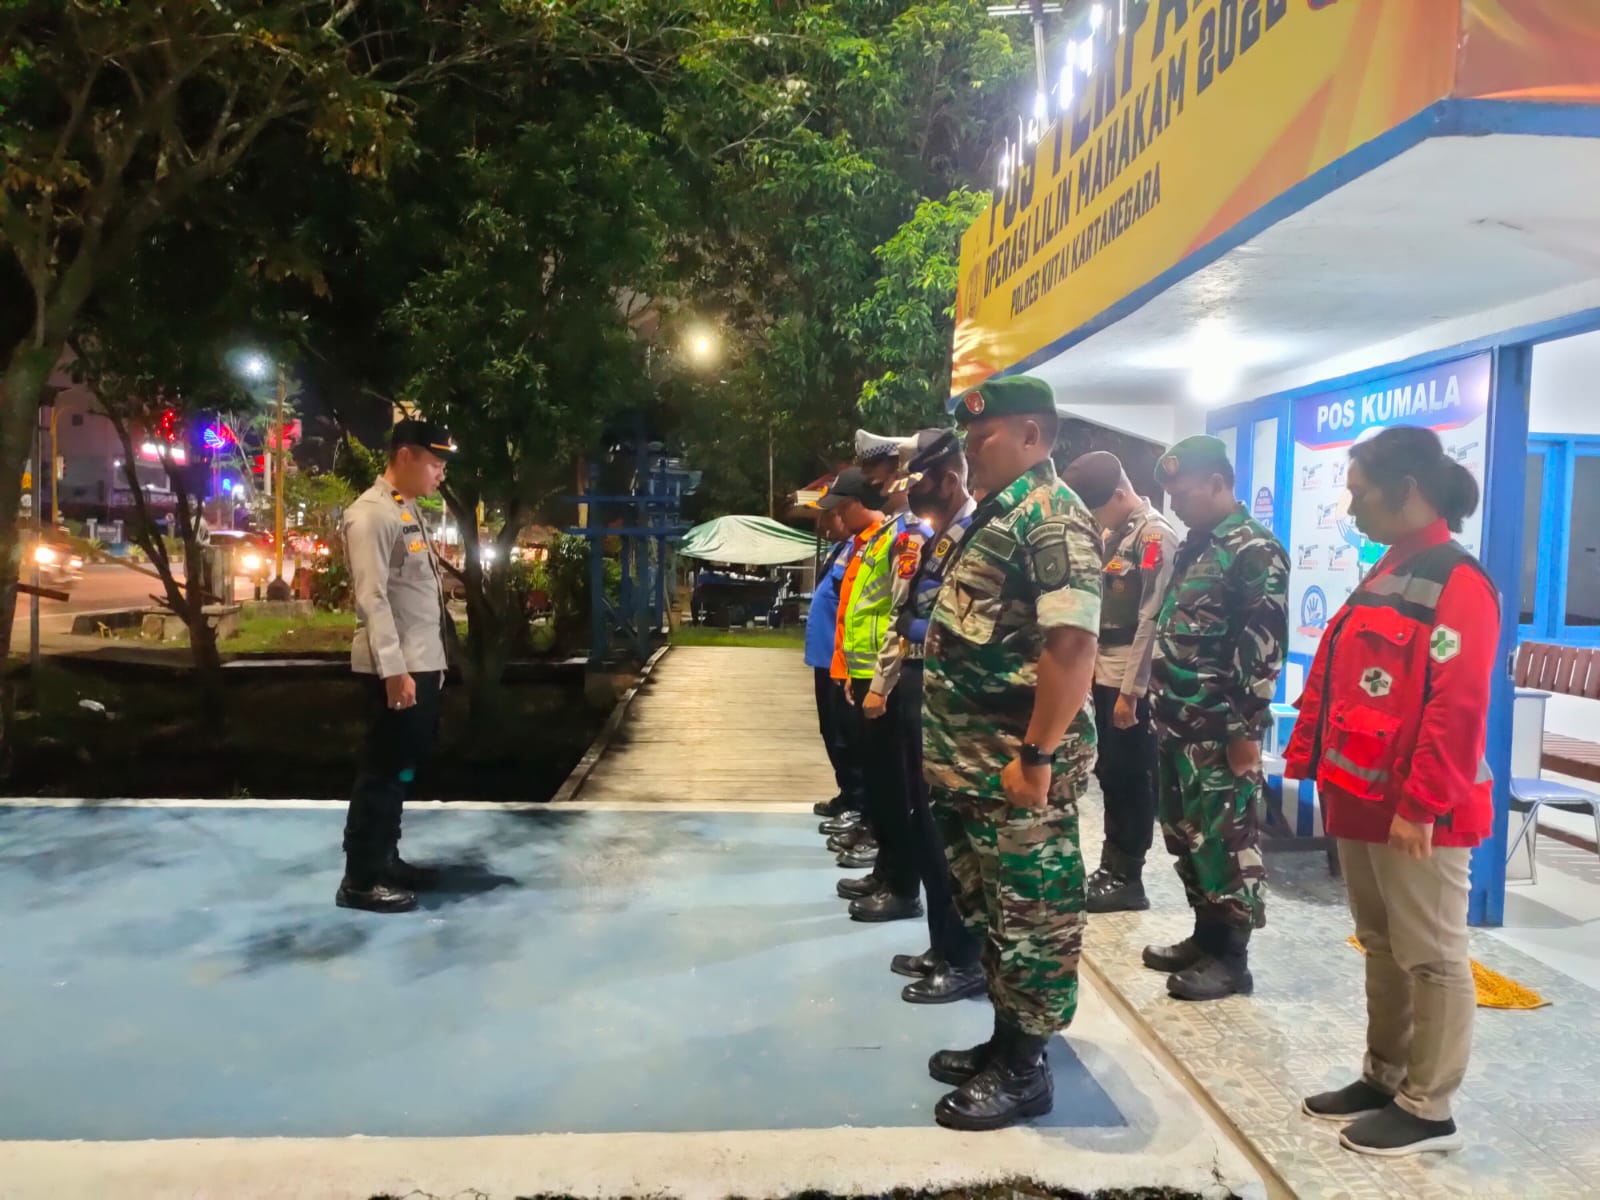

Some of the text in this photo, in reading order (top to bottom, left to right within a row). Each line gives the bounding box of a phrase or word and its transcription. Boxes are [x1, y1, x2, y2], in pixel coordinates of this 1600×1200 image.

[984, 215, 1031, 298] OPERASI
[1033, 170, 1072, 256] LILIN
[1076, 38, 1188, 216] MAHAKAM
[1011, 161, 1160, 320] POLRES KUTAI KARTANEGARA
[1317, 375, 1461, 432] POS KUMALA
